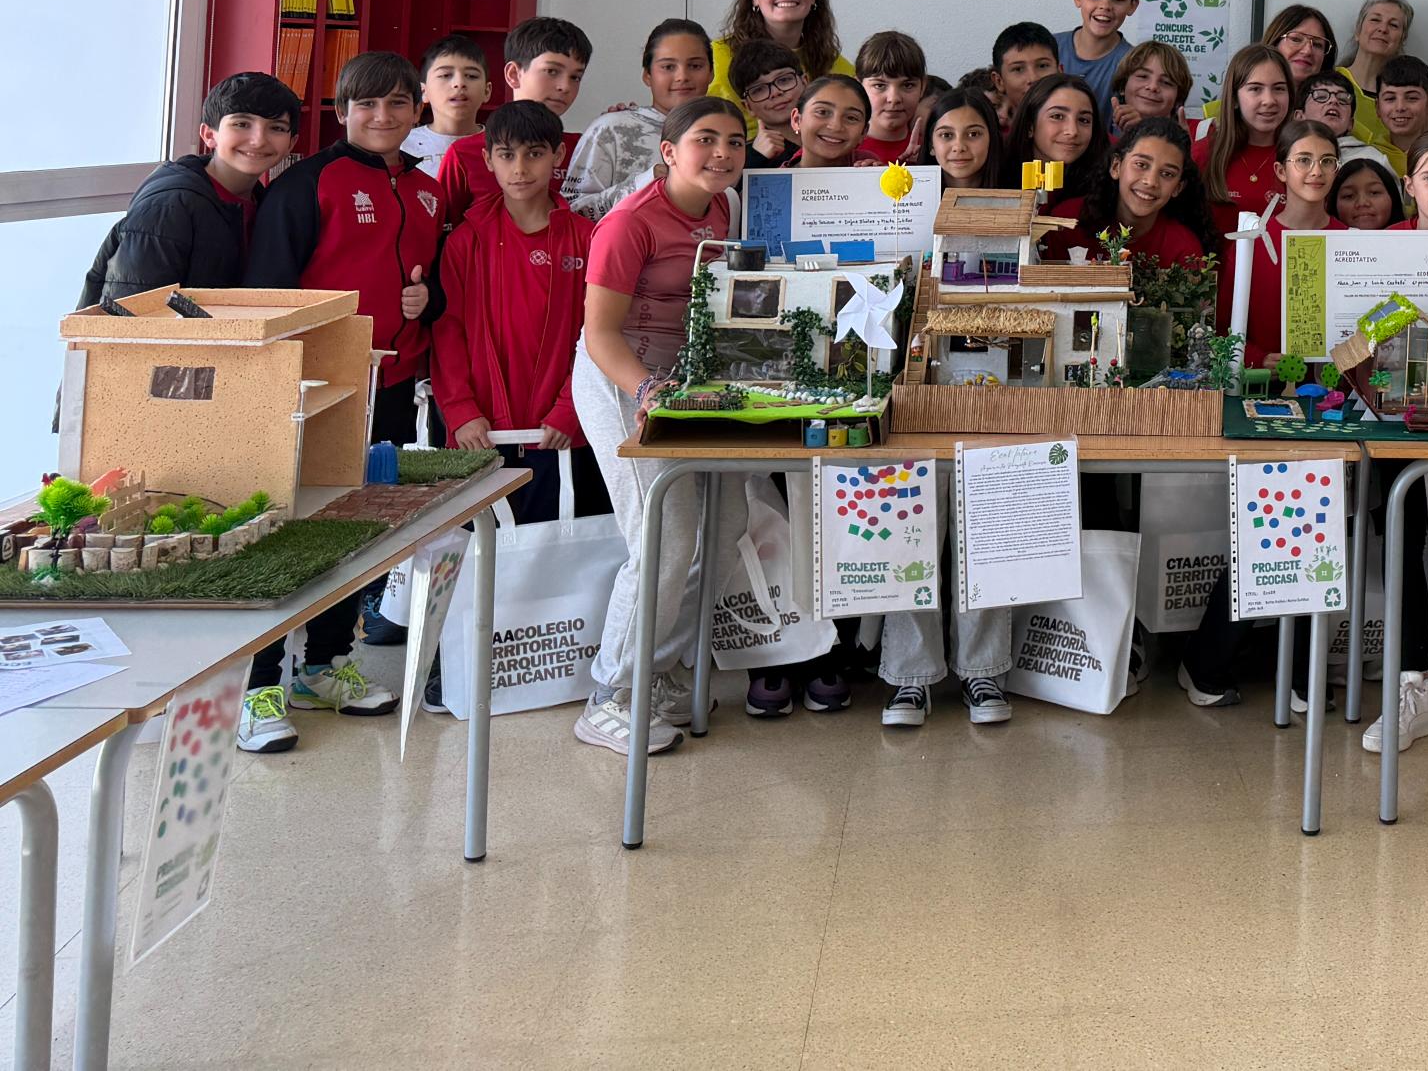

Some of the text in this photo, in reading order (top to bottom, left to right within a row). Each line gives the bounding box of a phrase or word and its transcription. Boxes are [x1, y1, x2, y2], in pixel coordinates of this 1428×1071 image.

[1155, 23, 1194, 33] CONCURS
[1153, 34, 1196, 44] PROJECTE
[357, 213, 377, 224] HBL
[836, 562, 889, 572] PROJECTE
[1166, 554, 1228, 570] CTAACOL
[1252, 560, 1302, 573] PROJECTE
[840, 574, 886, 584] ECOCASA
[1165, 568, 1228, 585] TERRITO
[1256, 573, 1298, 586] ECOCASA
[492, 618, 585, 645] AACOLEGIO
[492, 634, 579, 660] RRITORIAL
[1016, 657, 1082, 682] DEALICANTE
[490, 663, 575, 690] ALICANTE
